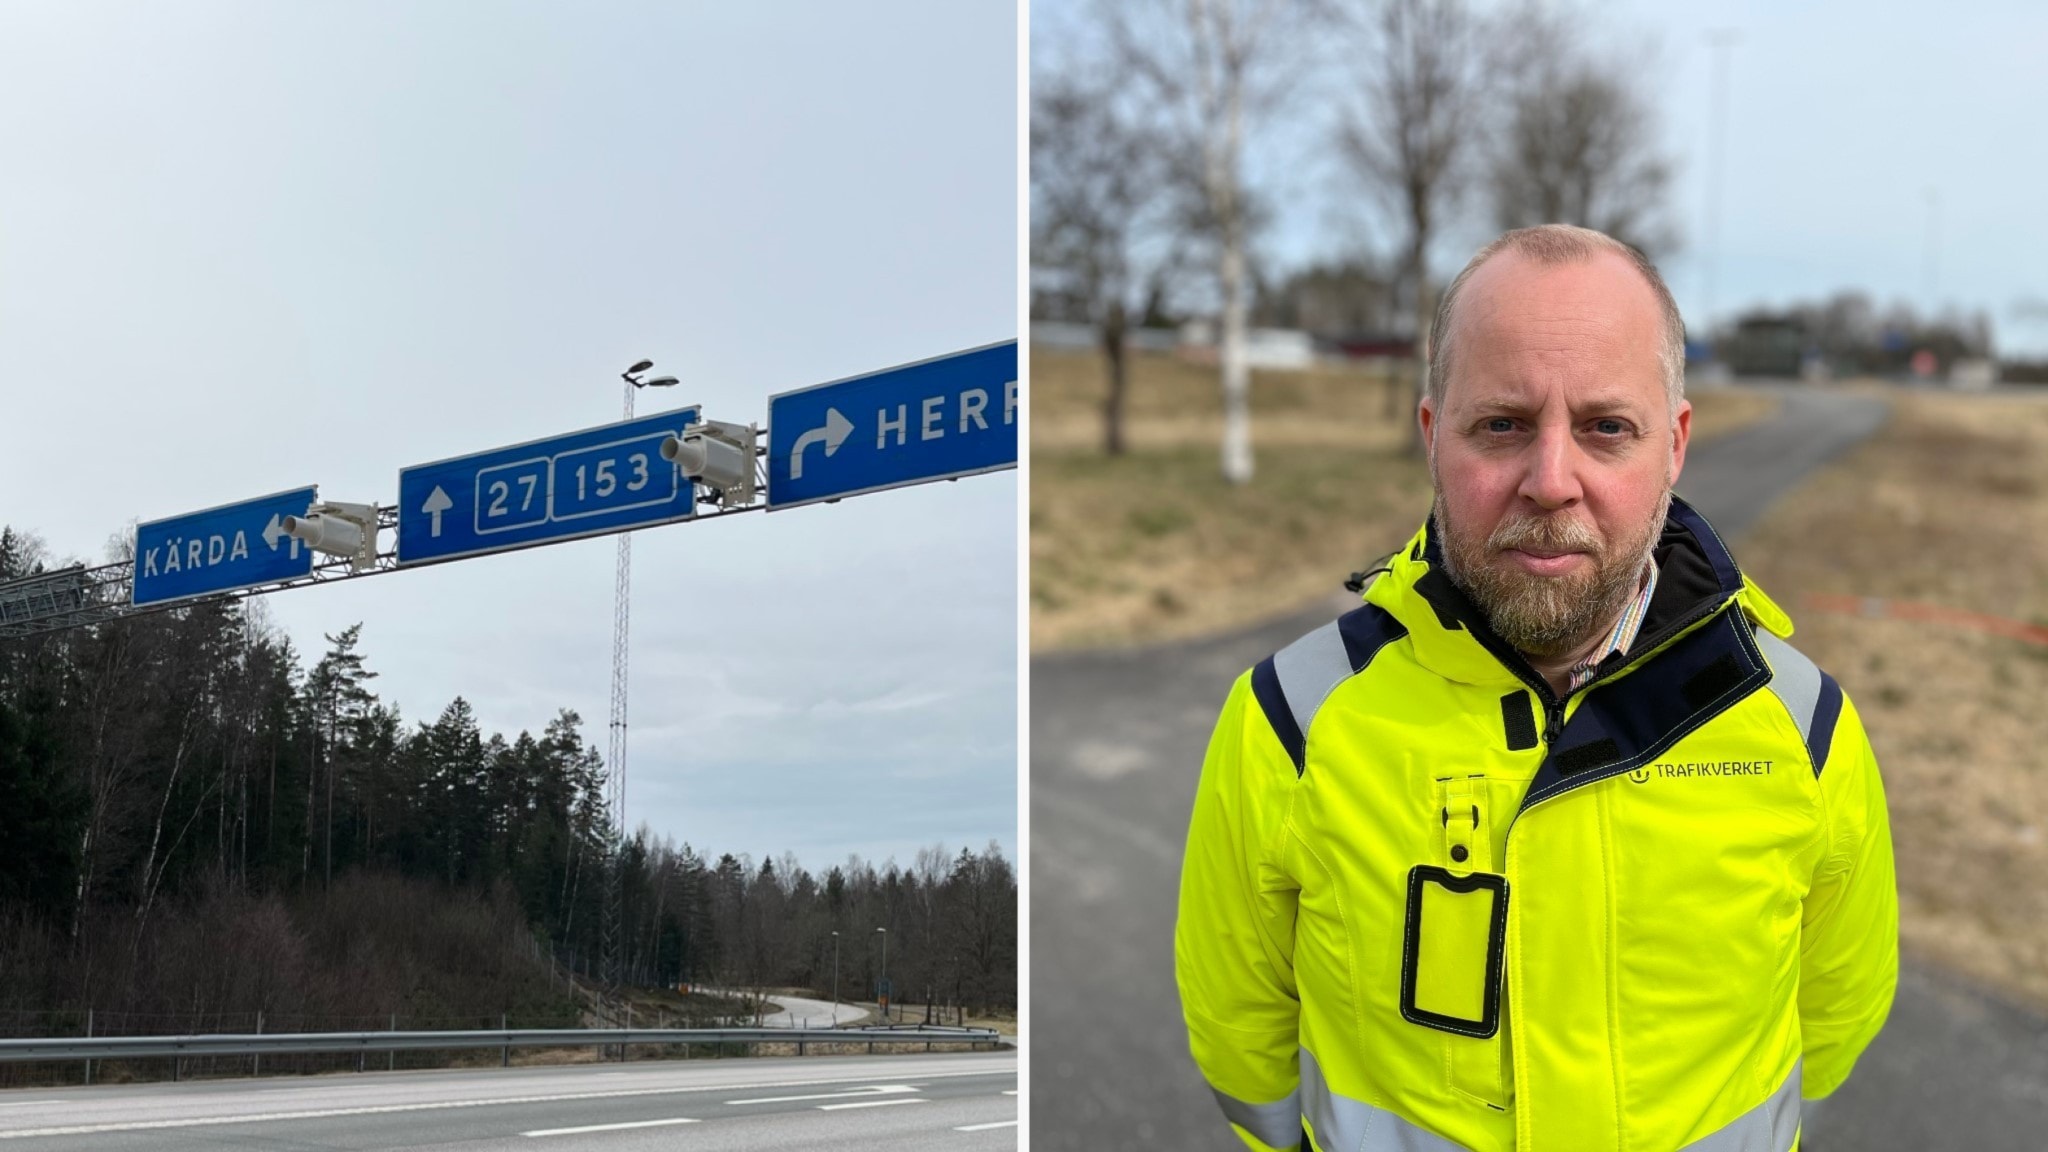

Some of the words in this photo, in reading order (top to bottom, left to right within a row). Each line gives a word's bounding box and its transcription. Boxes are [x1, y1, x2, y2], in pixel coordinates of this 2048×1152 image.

[488, 474, 538, 517] 27
[575, 453, 648, 501] 153
[143, 530, 249, 578] KÄRDA
[1654, 761, 1773, 778] TRAFIKVERKET
